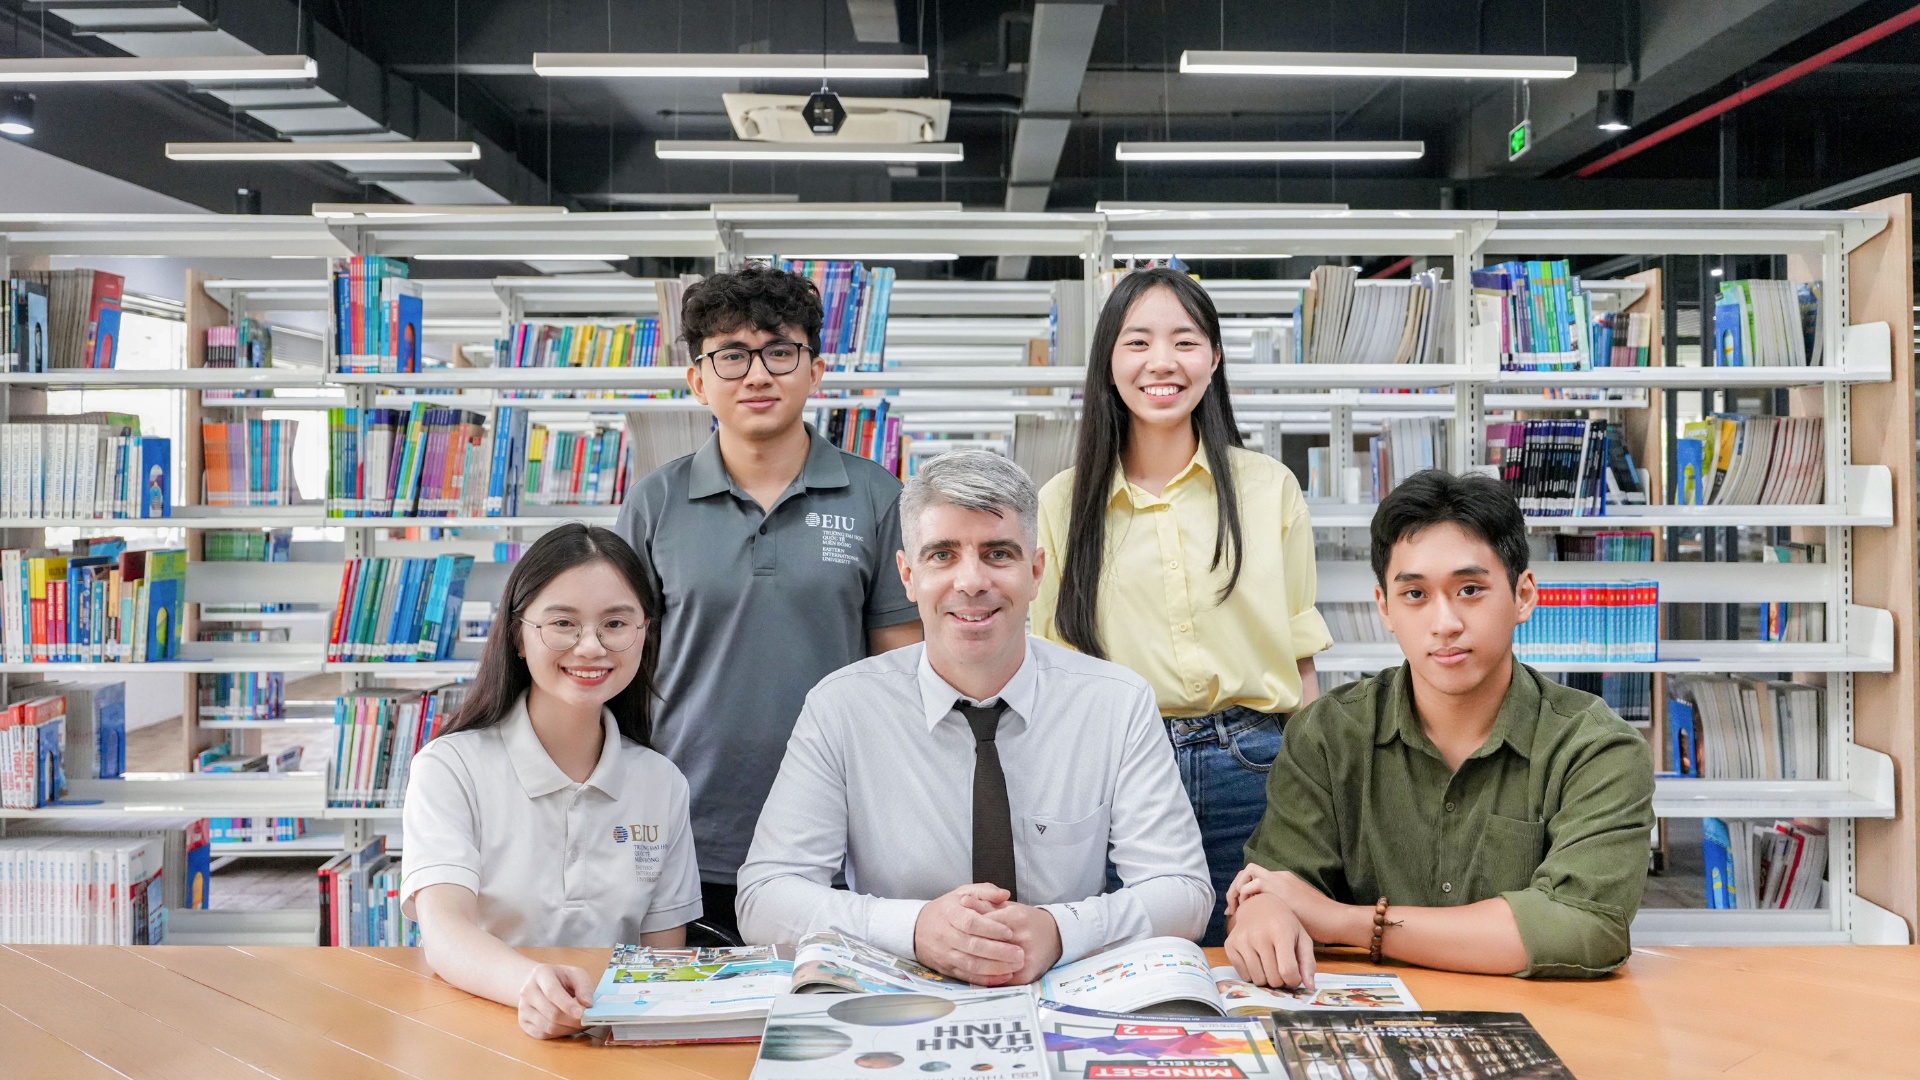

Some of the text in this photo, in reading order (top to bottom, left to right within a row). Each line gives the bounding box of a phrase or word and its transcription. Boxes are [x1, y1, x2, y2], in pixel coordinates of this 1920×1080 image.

[822, 514, 855, 530] EIU
[13, 751, 23, 780] TOEFL
[629, 825, 659, 842] EIU
[934, 1022, 1030, 1037] TINH
[1123, 1025, 1139, 1034] 2
[1095, 1068, 1232, 1077] MINDSET
